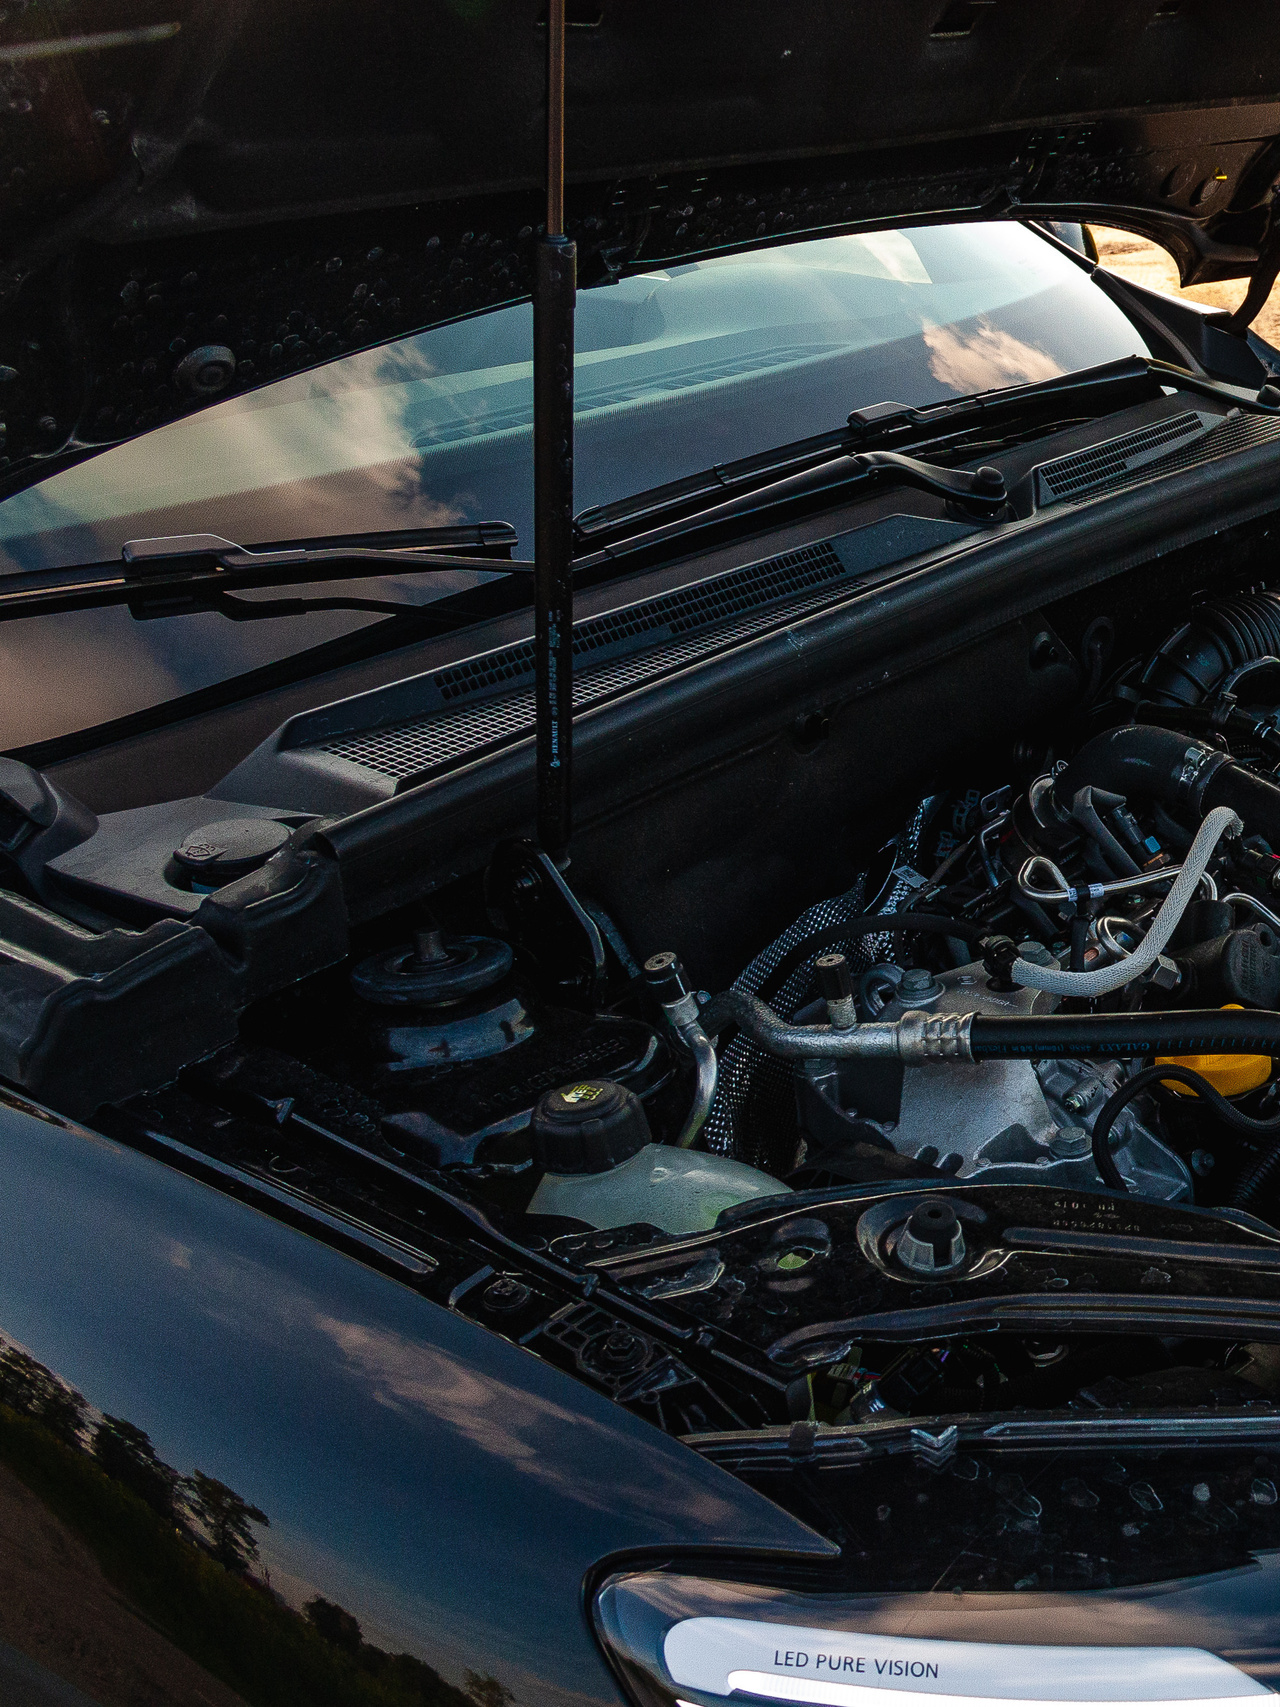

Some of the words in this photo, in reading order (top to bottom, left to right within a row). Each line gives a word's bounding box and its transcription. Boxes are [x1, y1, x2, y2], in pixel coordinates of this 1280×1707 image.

[551, 720, 559, 754] RENAULT
[1099, 1042, 1151, 1052] GALAXY
[774, 1650, 809, 1668] LED
[815, 1653, 866, 1673] PURE
[874, 1658, 939, 1679] VISION
